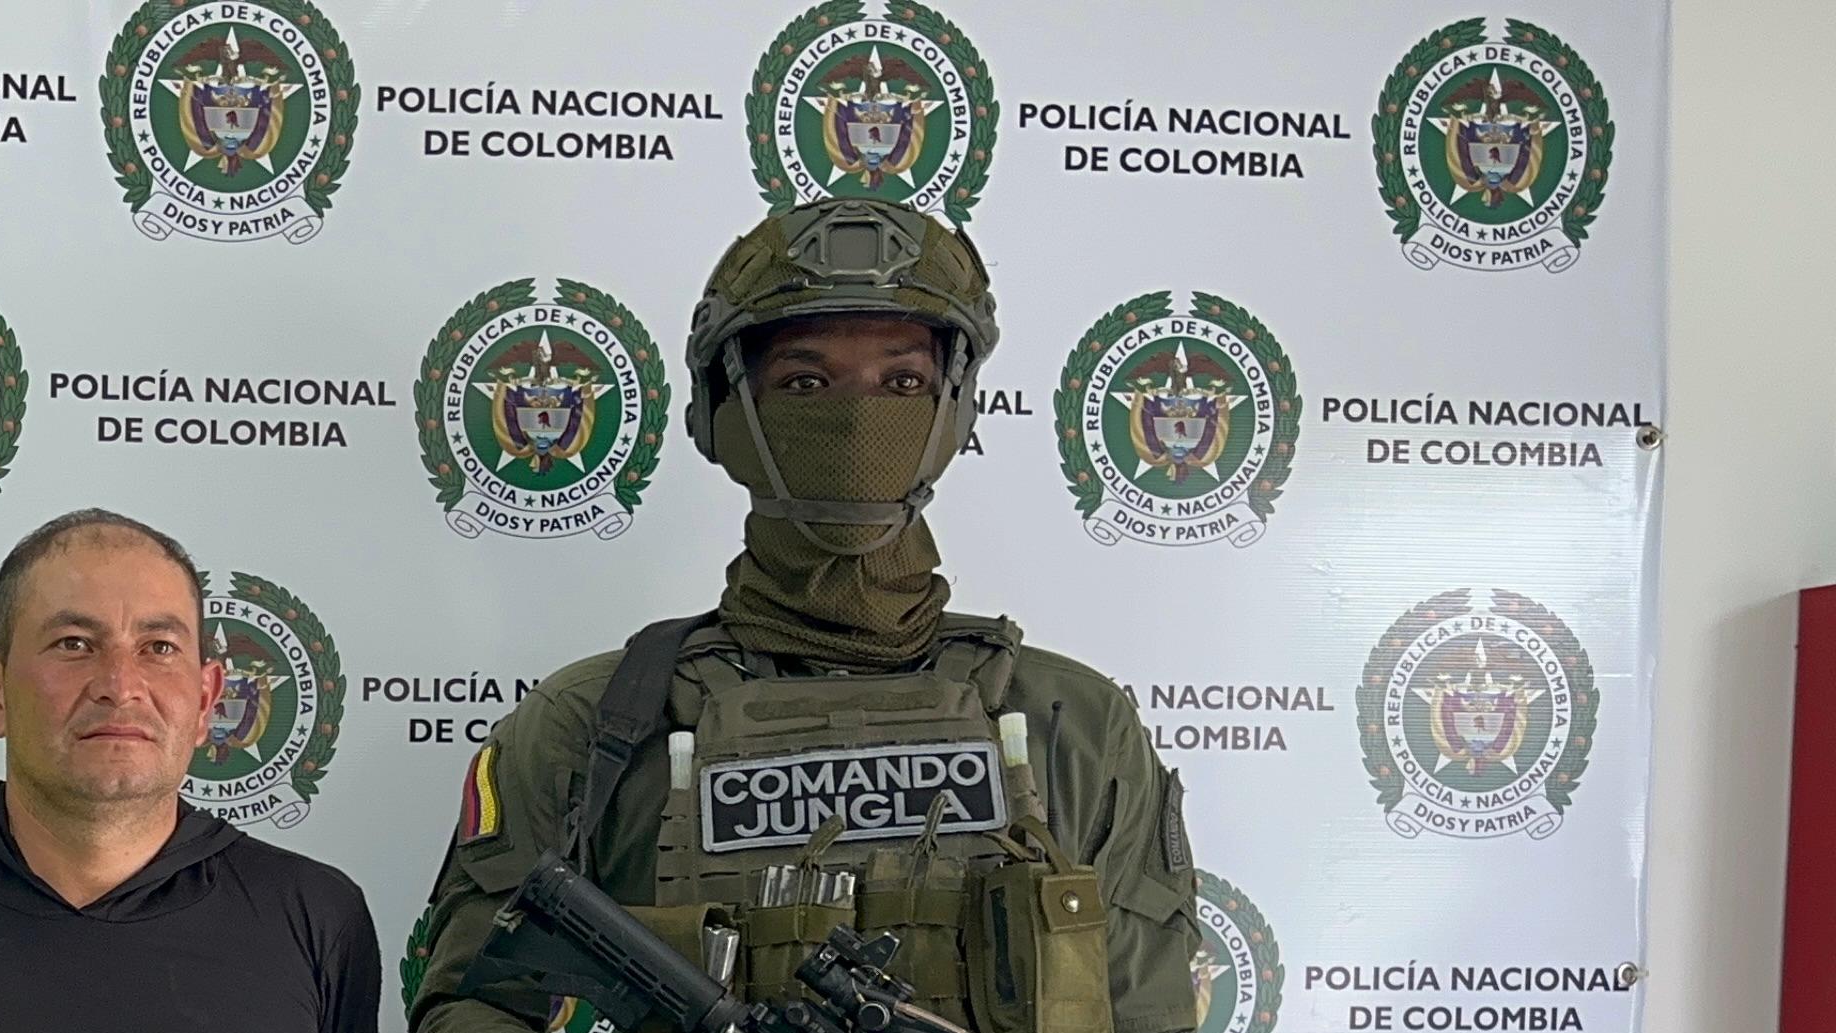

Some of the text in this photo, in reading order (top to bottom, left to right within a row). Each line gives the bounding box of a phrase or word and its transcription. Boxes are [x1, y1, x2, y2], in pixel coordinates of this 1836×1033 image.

[133, 5, 327, 125] REPÚBLICA DE COLOMBIA
[378, 82, 722, 119] POLICÍA NACIONAL
[1403, 47, 1583, 161] REPÚBLICA DE COLOMBIA
[1020, 100, 1350, 138] POLICÍA NACIONAL
[425, 131, 673, 160] DE COLOMBIA
[1065, 146, 1303, 178] DE COLOMBIA
[230, 151, 317, 210] NACIONAL
[163, 203, 294, 235] DIOS Y PATRIA
[1493, 185, 1574, 241] NACIONAL
[1430, 234, 1553, 264] DIOS Y PATRIA
[447, 308, 637, 424] REPÚBLICA DE COLOMBIA
[1086, 321, 1270, 434] REPÚBLICA DE COLOMBIA
[51, 369, 396, 406] POLICÍA NACIONAL
[1323, 393, 1653, 429] POLICÍA NACIONAL
[99, 417, 346, 447] DE COLOMBIA
[1368, 439, 1602, 466] DE COLOMBIA
[541, 449, 627, 508] NACIONAL
[1177, 459, 1260, 516] NACIONAL
[475, 502, 604, 532] DIOS Y PATRIA
[1113, 510, 1238, 539] DIOS Y PATRIA
[364, 672, 503, 702] POLICÍA
[1151, 685, 1334, 710] NACIONAL
[410, 719, 453, 742] DE
[1143, 726, 1287, 752] LOMBIA
[713, 753, 986, 805] COMANDO
[733, 788, 972, 838] JUNGLA
[1306, 960, 1440, 990] POLICÍA
[1350, 1007, 1582, 1030] DE COLOMBIA
